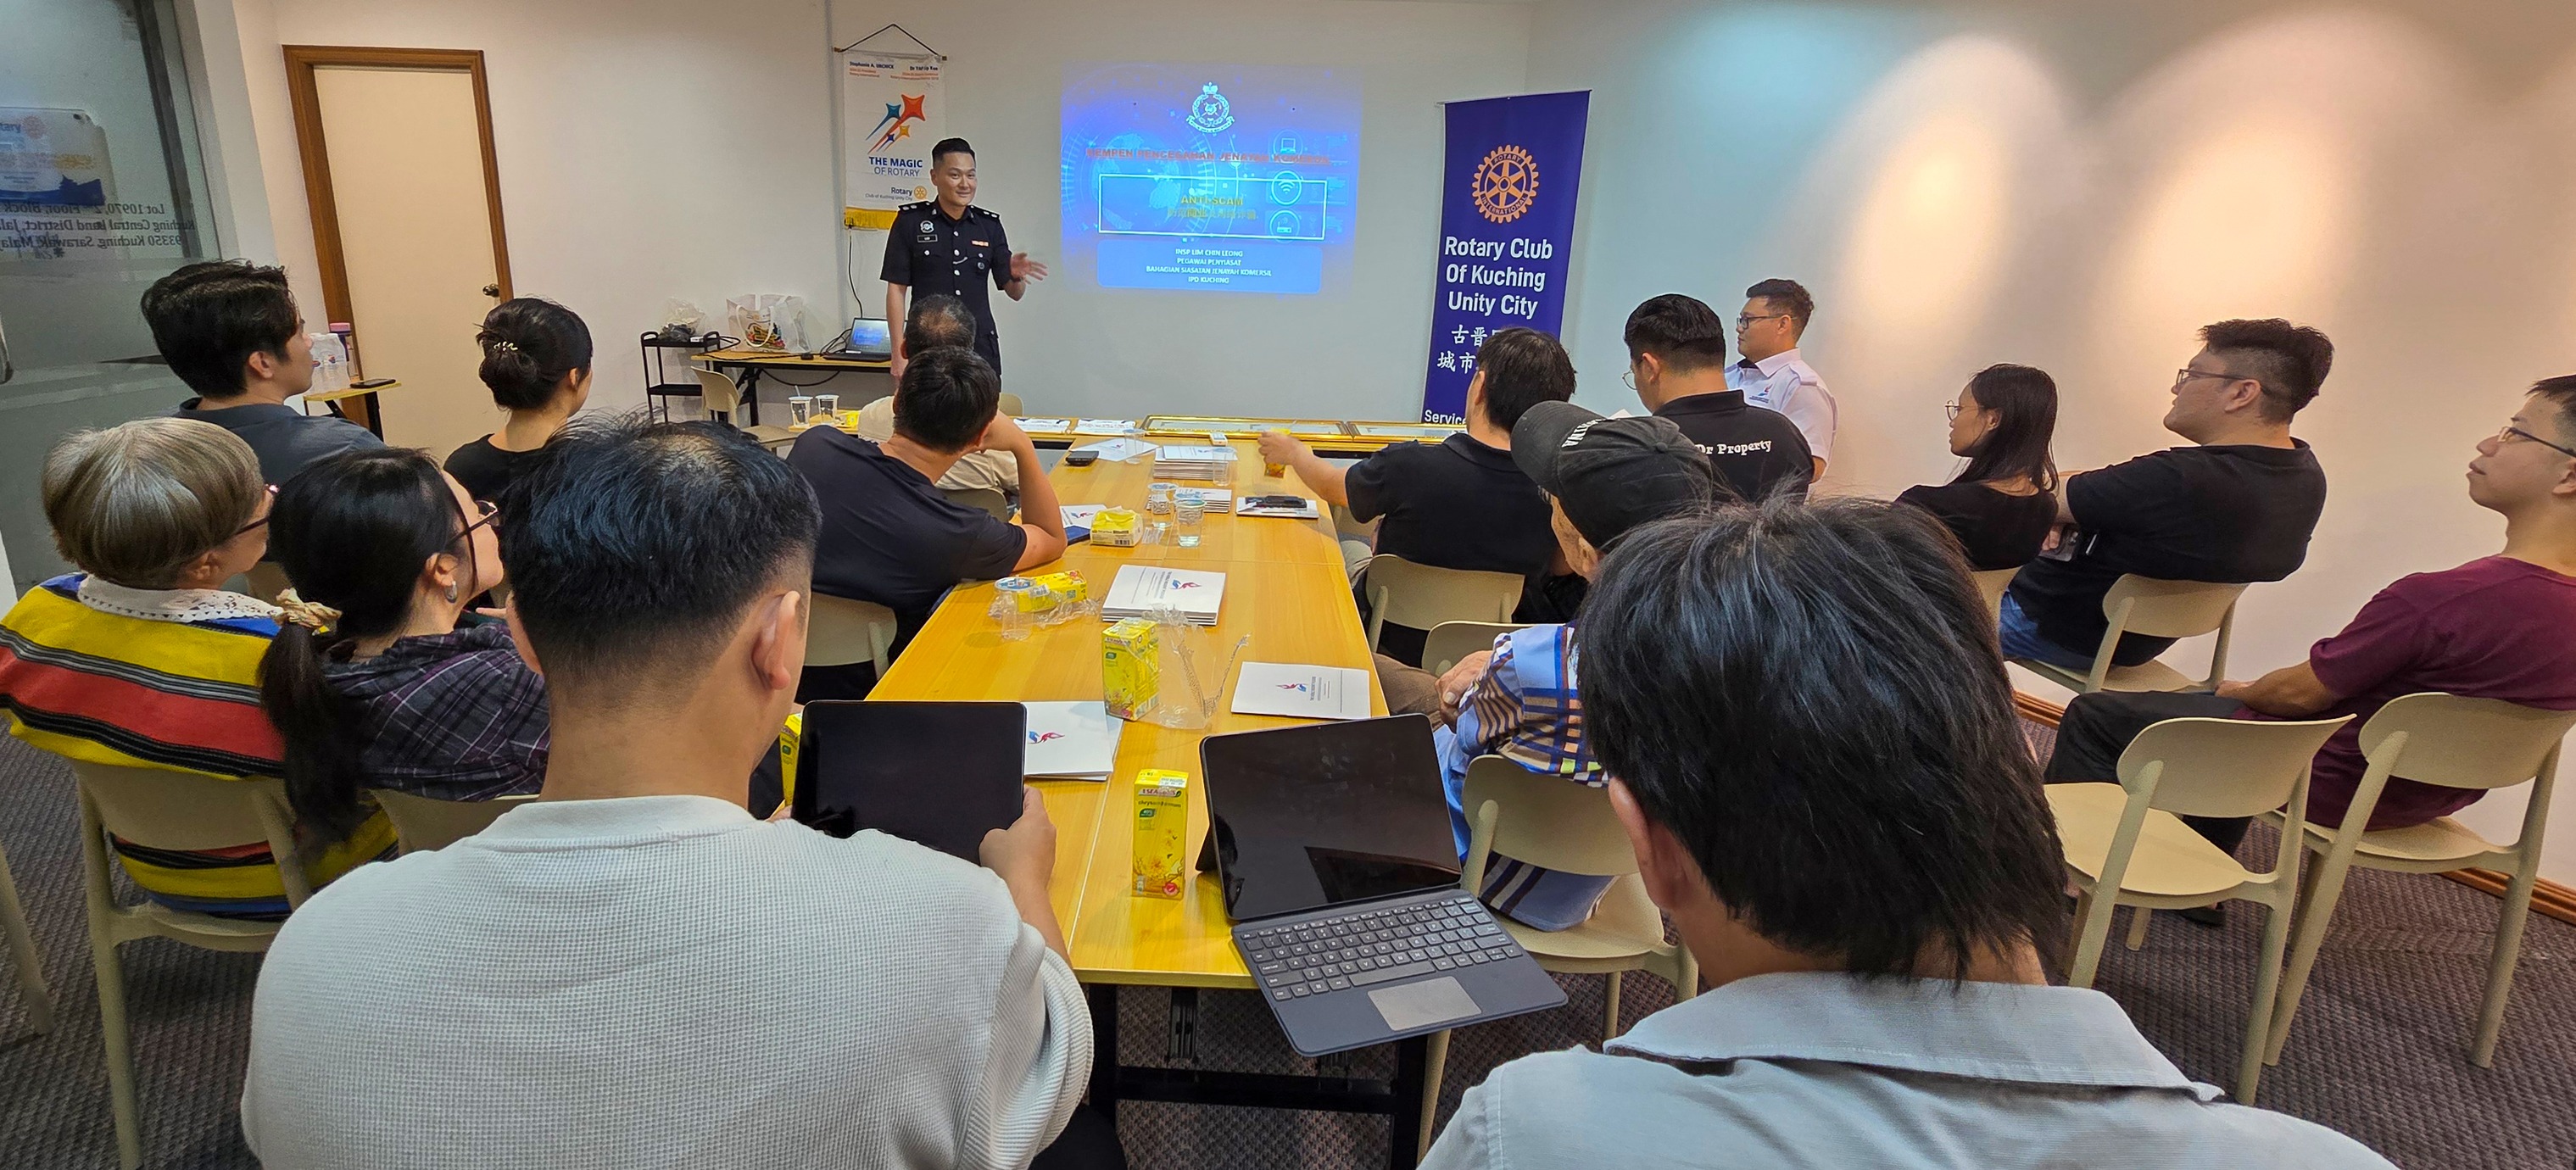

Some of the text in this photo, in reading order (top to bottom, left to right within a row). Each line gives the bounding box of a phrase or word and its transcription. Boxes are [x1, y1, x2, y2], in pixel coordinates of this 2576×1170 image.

[869, 156, 923, 168] THE MAGIC
[1493, 153, 1522, 164] ROTARY
[874, 166, 920, 176] OF ROTARY
[890, 187, 913, 196] Rotary
[1481, 196, 1528, 214] INTERNATIONAL
[1445, 237, 1553, 261] Rotary Club
[1446, 264, 1546, 292] Of Kuching
[1448, 291, 1539, 320] Unity City
[1437, 350, 1479, 374] 城市
[1717, 440, 1772, 456] Property
